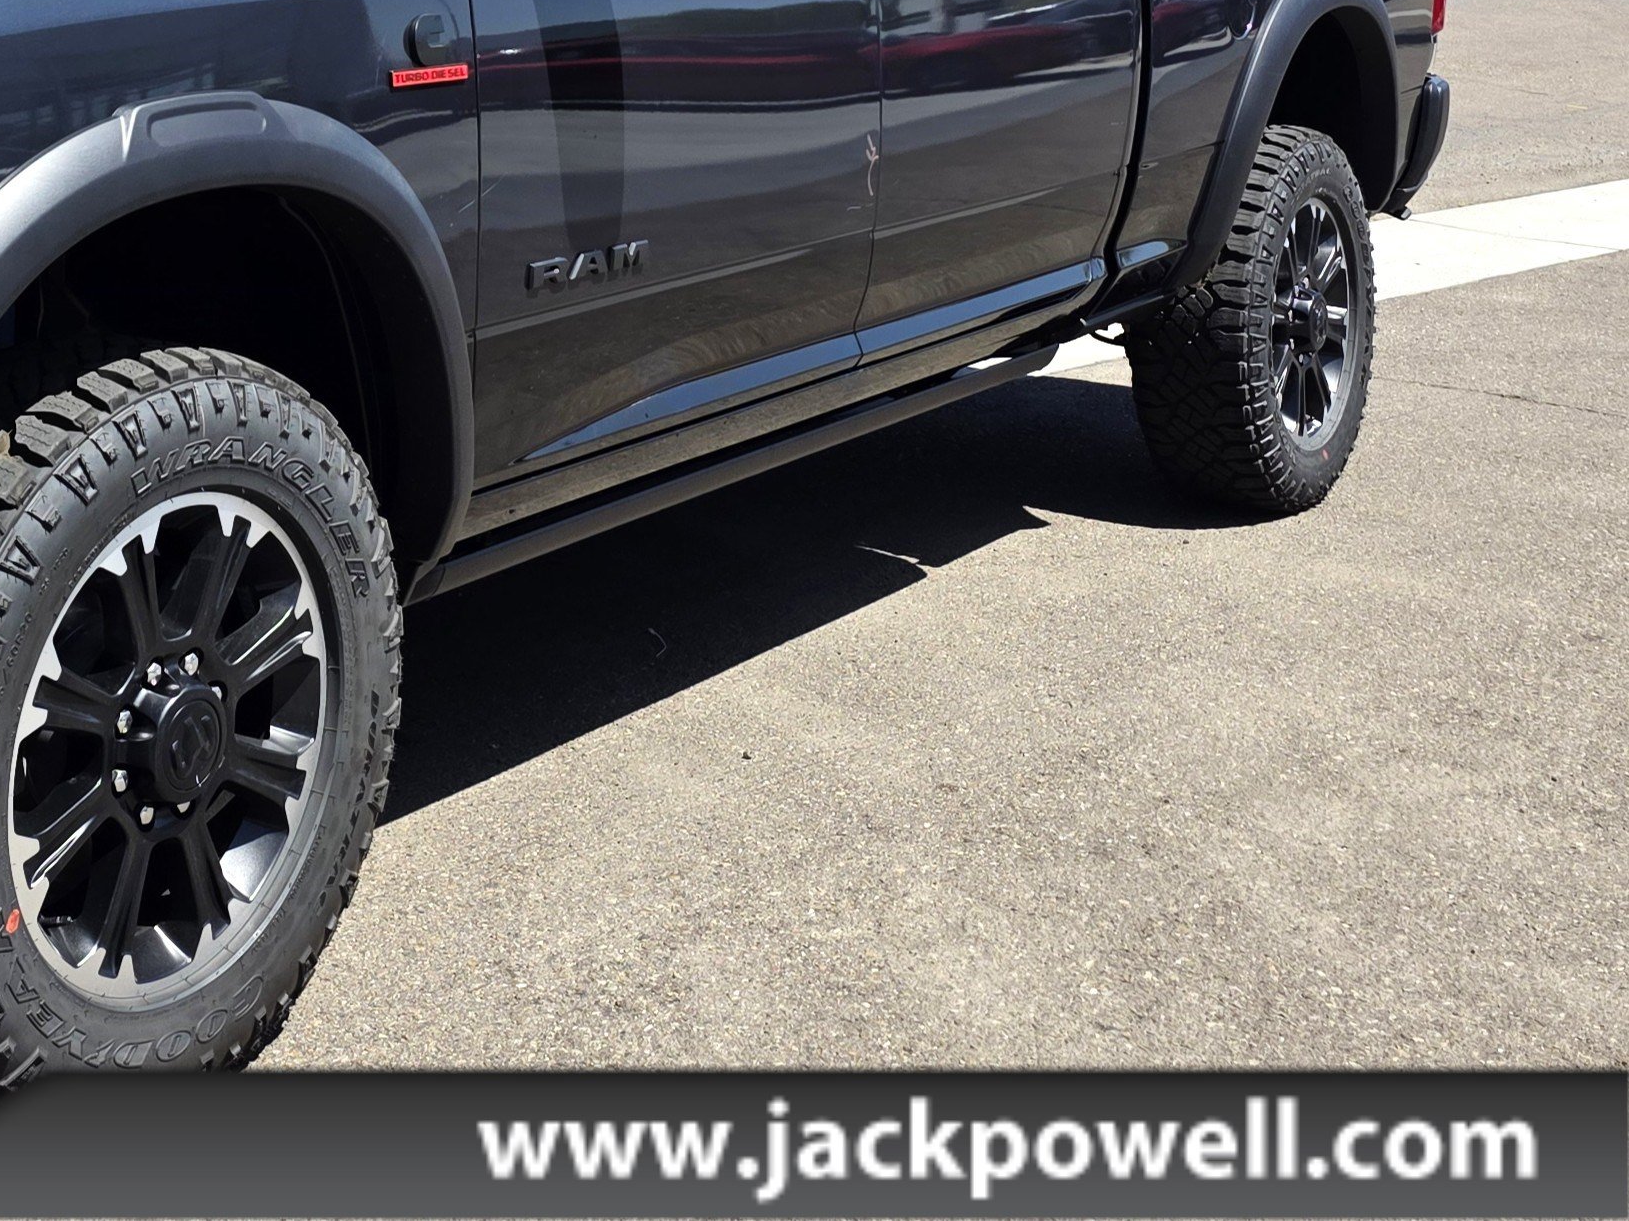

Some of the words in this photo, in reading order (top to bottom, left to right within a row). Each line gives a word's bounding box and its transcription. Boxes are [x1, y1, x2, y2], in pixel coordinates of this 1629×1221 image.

[395, 71, 430, 83] TURBO
[431, 66, 466, 79] DIESEL
[525, 239, 649, 291] RAM
[130, 435, 371, 598] WRANGLER
